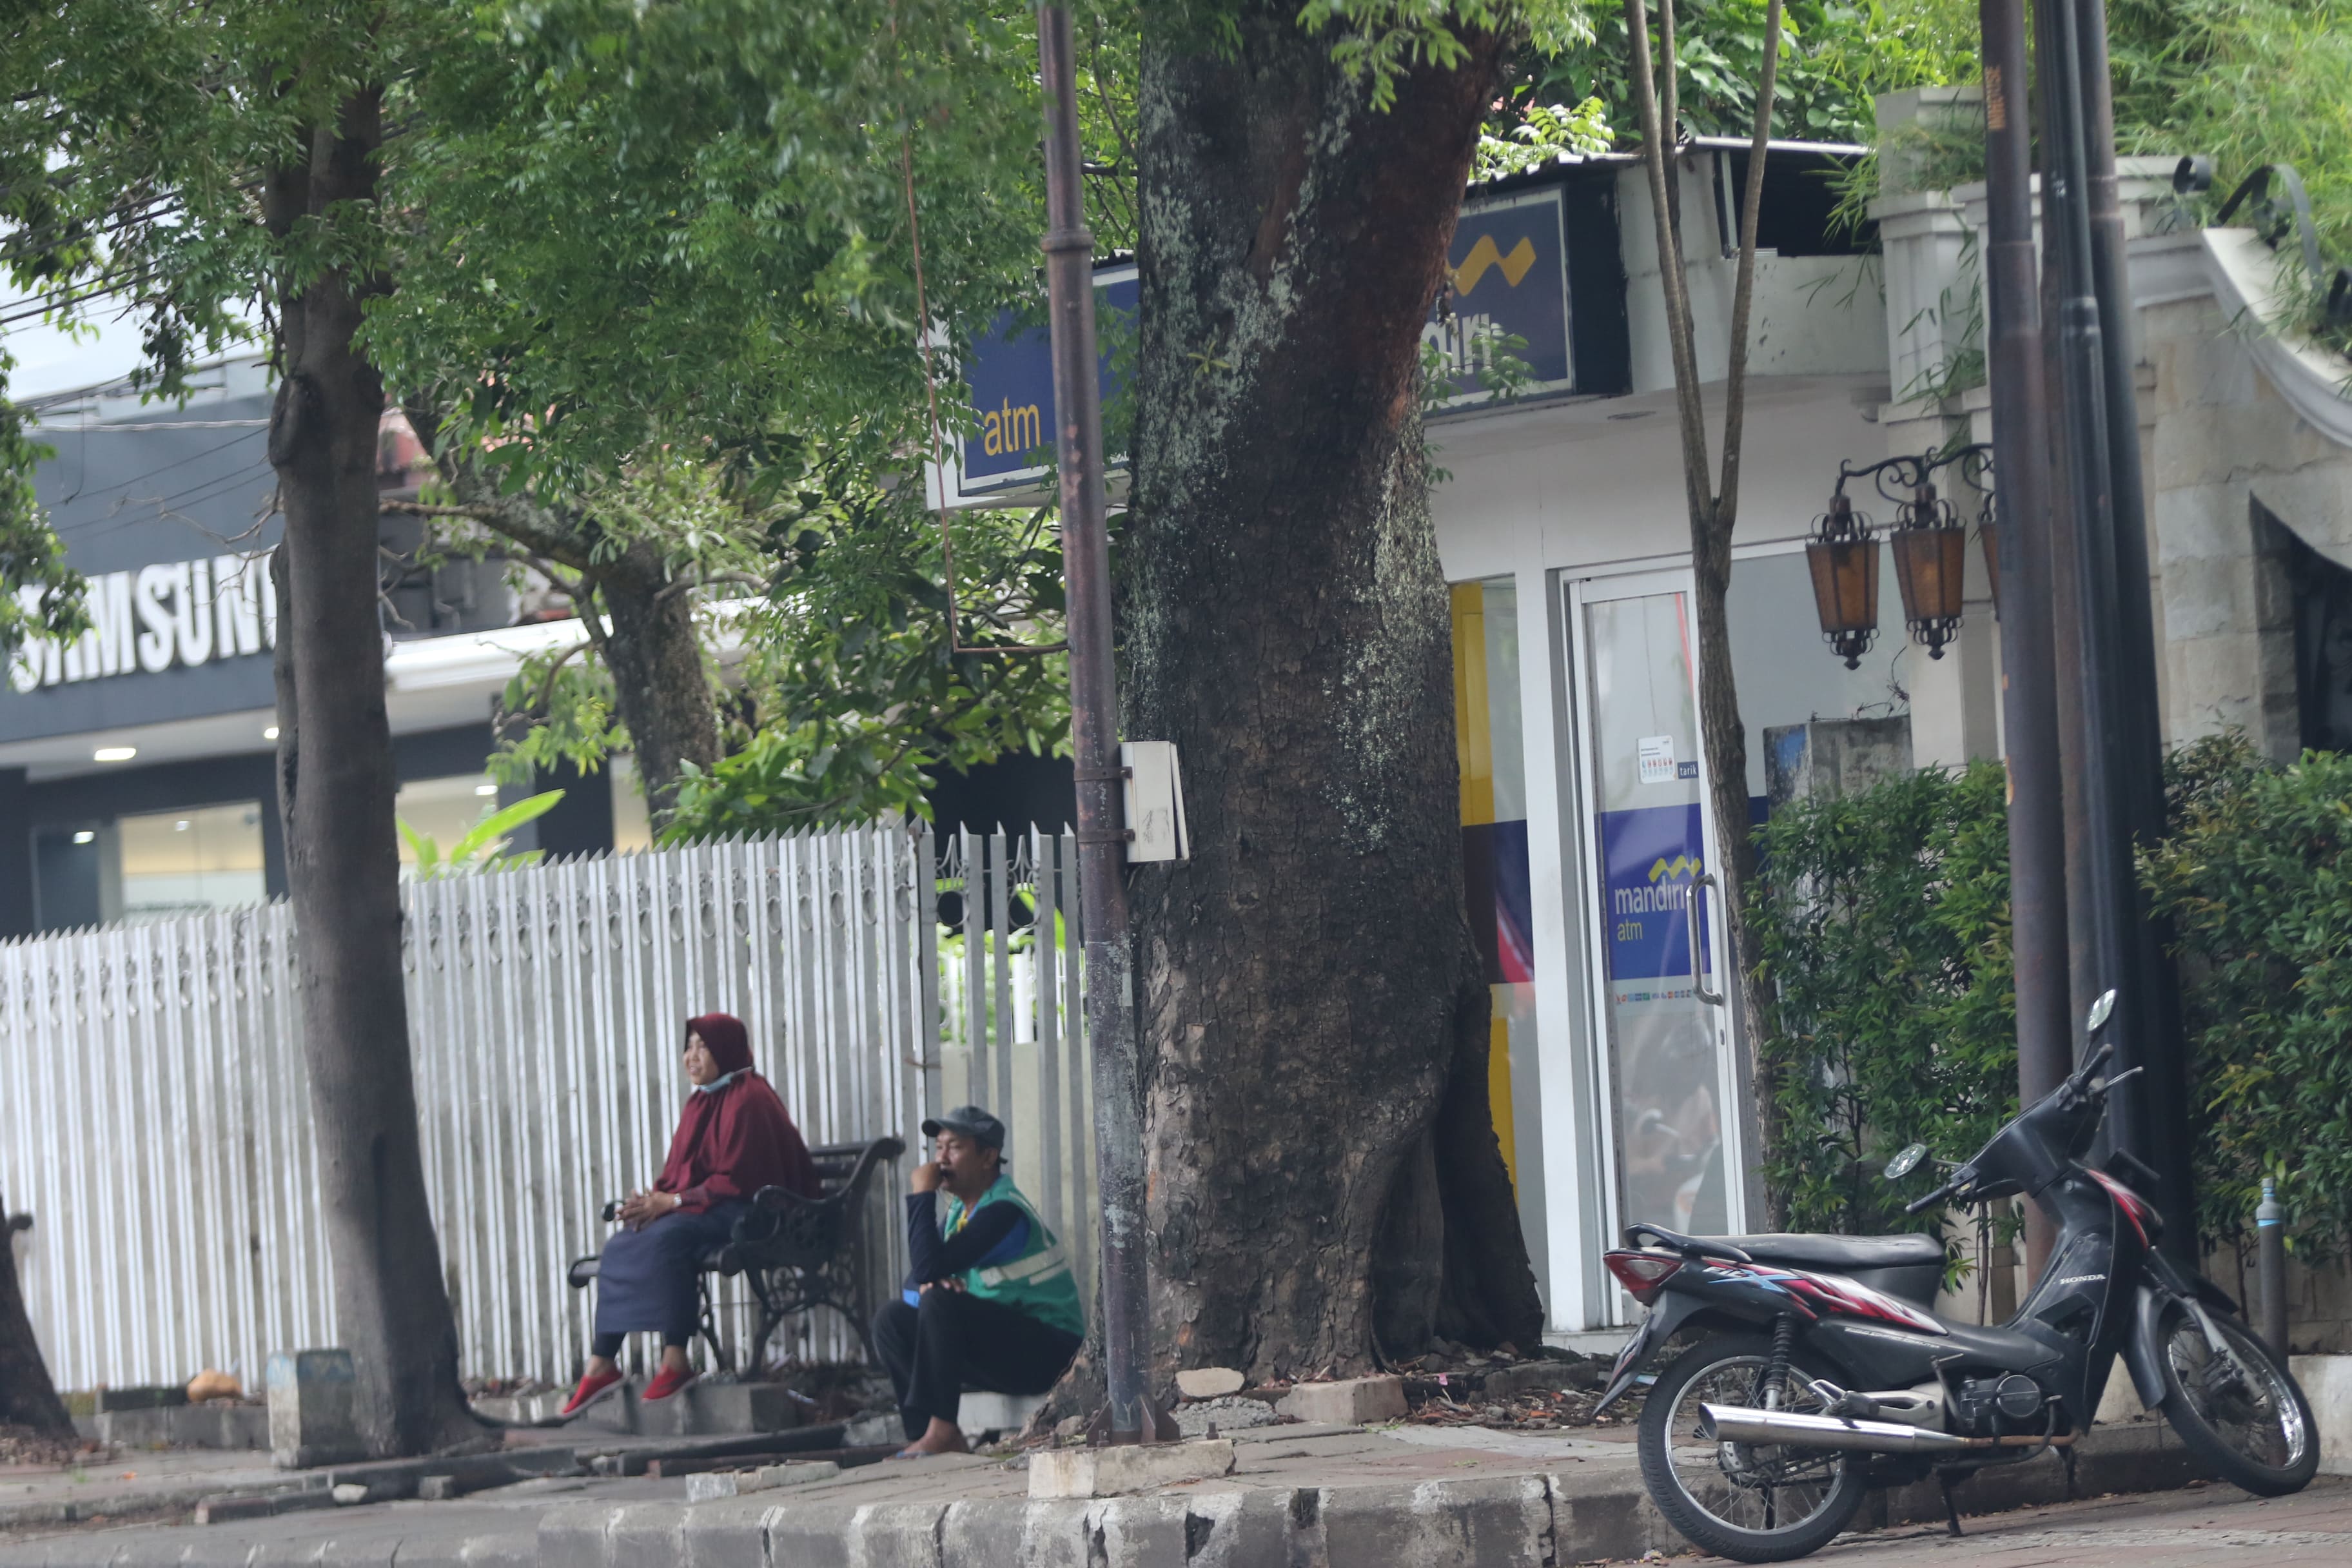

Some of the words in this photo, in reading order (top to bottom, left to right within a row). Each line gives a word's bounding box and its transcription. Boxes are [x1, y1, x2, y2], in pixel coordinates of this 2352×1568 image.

[985, 396, 1040, 456] atm
[1680, 764, 1697, 776] tarik
[1614, 875, 1685, 914] mandiri
[1617, 918, 1643, 941] atm
[2060, 1274, 2106, 1284] HONDA
